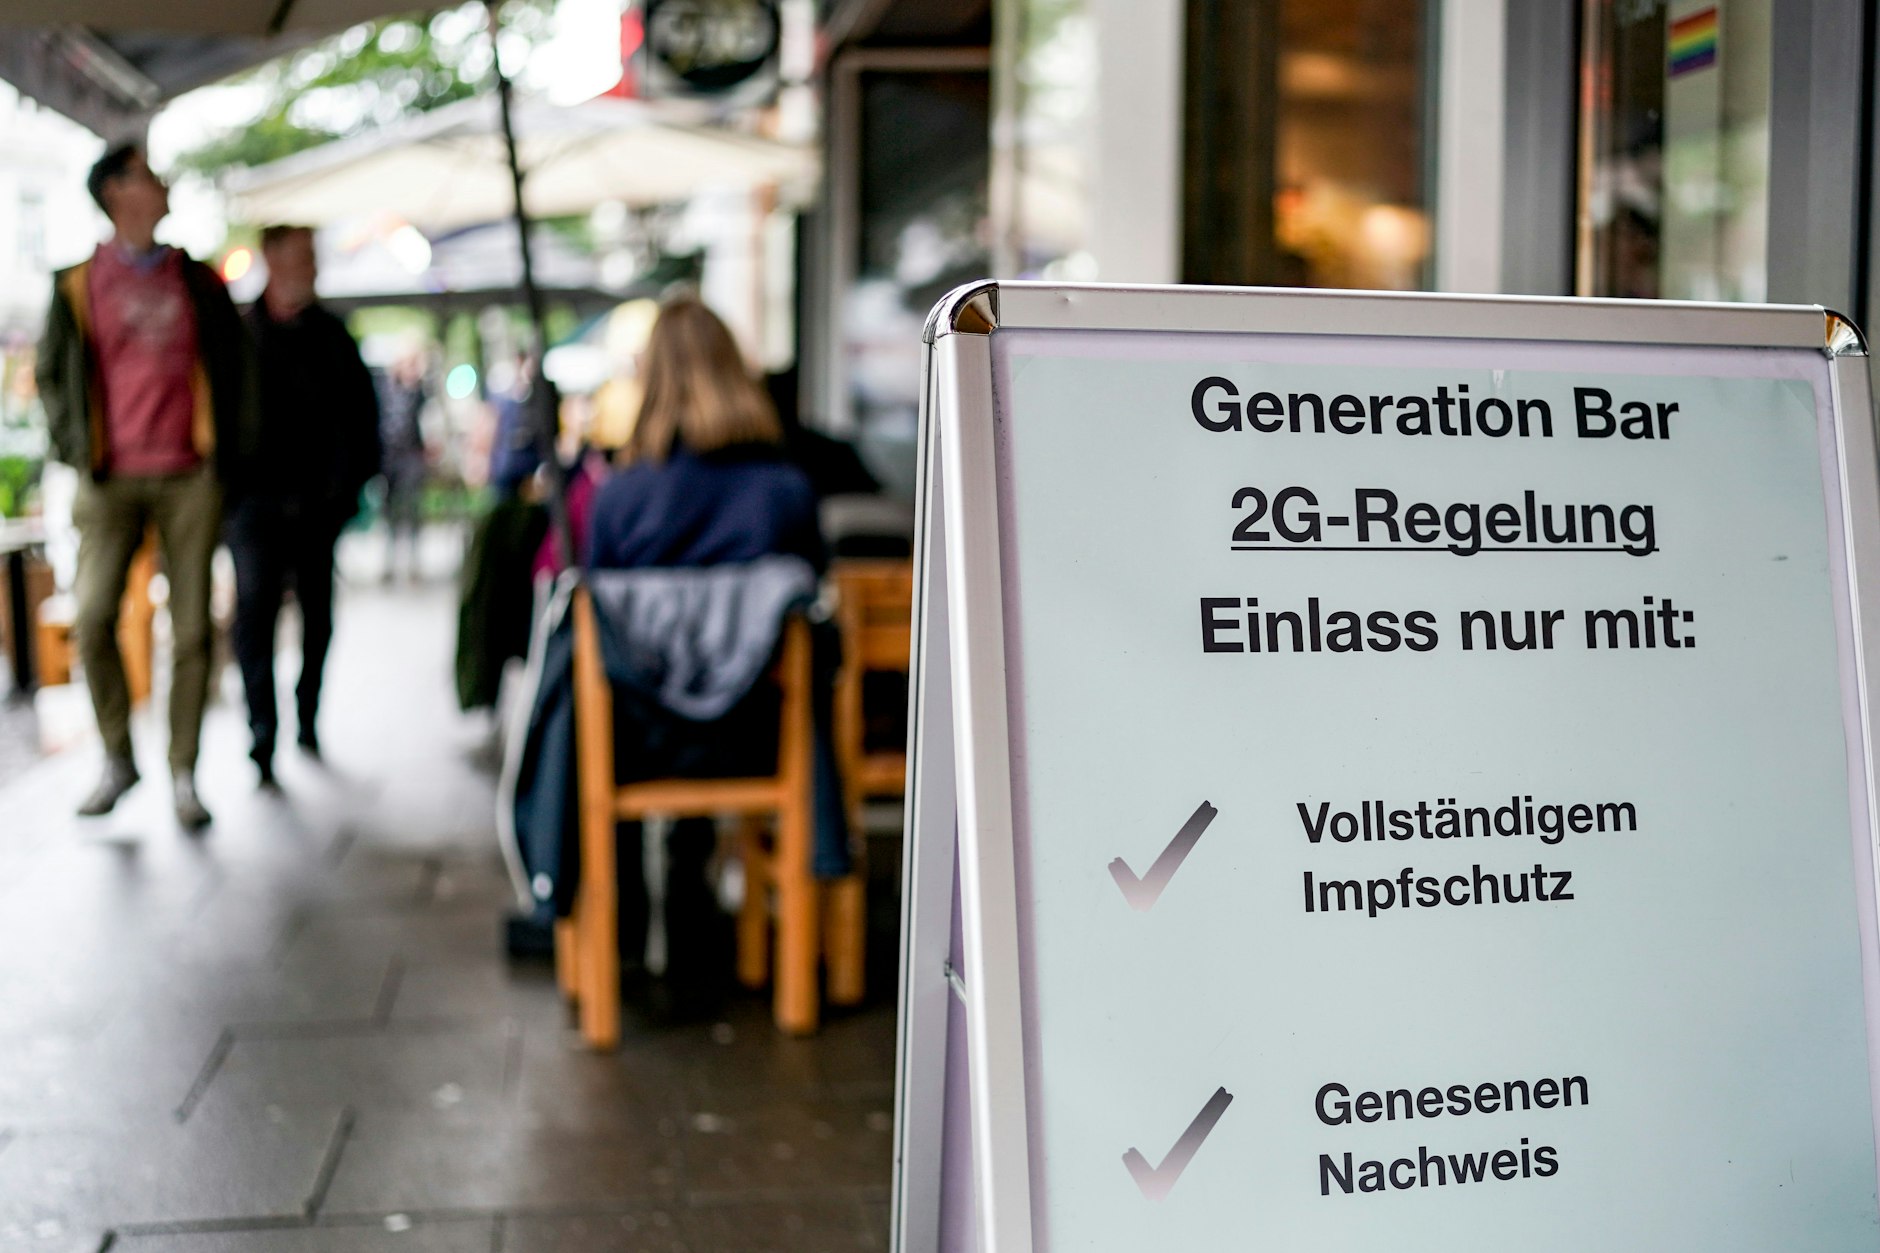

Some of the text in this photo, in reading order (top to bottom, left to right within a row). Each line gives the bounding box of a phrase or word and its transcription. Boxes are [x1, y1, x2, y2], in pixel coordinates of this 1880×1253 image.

[1191, 377, 1679, 441] Generation Bar
[1231, 486, 1659, 557] 2G-Regelung
[1201, 596, 1696, 654] Einlass nur mit:
[1297, 795, 1637, 845] Vollständigem
[1303, 863, 1575, 918] Impfschutz
[1314, 1075, 1589, 1126] Genesenen
[1319, 1137, 1559, 1196] Nachweis
